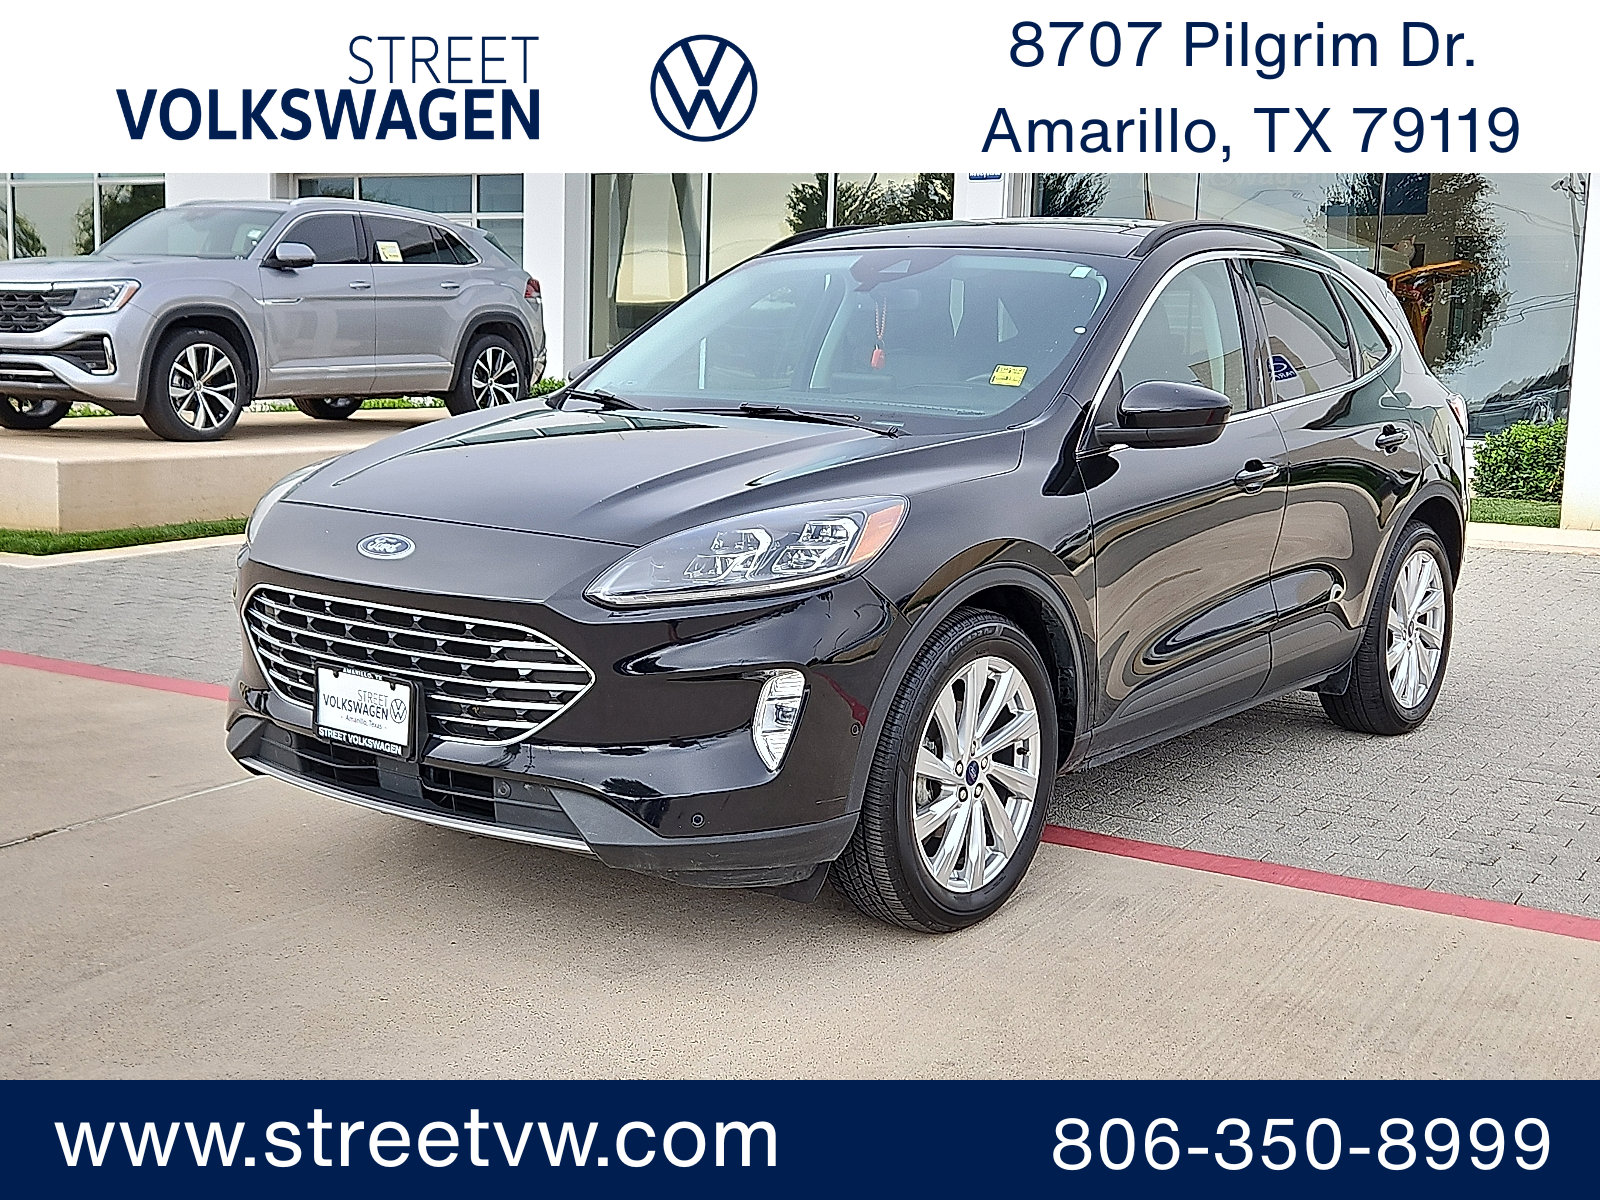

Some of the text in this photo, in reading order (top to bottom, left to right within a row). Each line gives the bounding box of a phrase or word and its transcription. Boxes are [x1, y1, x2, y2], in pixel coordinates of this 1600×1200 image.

[323, 693, 389, 721] VOLKSWAGEN
[357, 689, 389, 708] STREET
[318, 726, 402, 756] STREET VOLKSWAGEN
